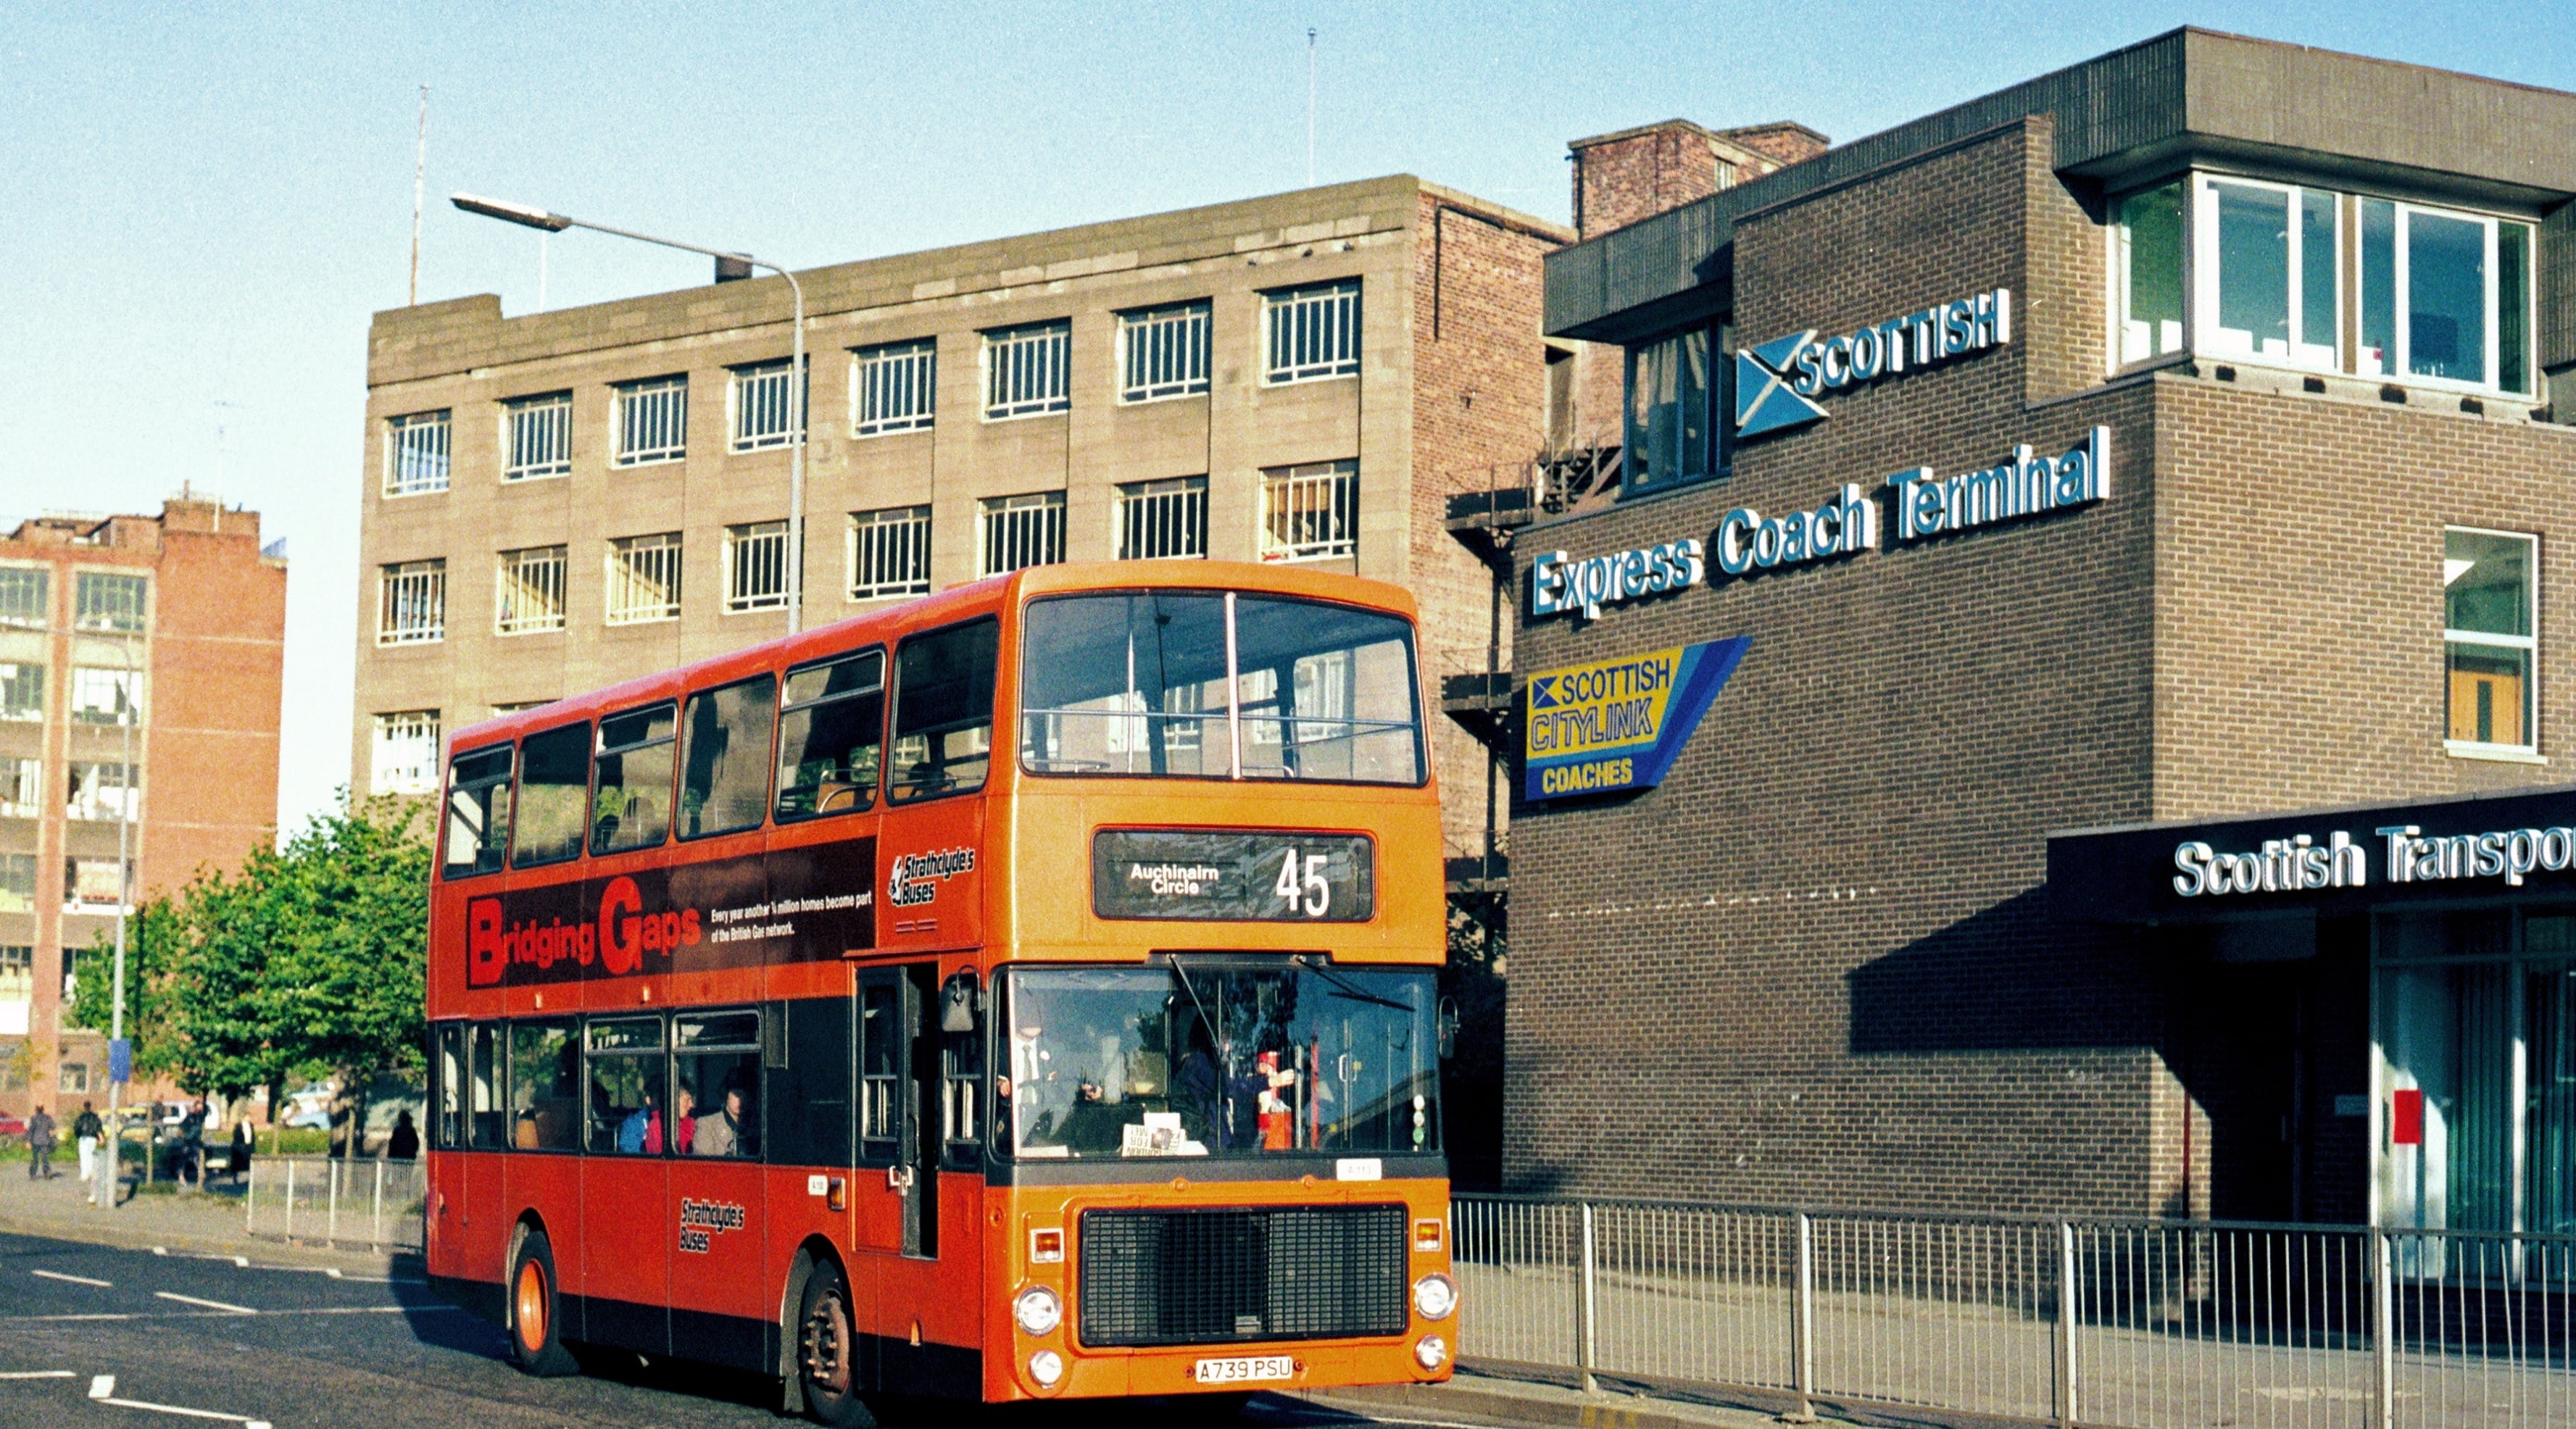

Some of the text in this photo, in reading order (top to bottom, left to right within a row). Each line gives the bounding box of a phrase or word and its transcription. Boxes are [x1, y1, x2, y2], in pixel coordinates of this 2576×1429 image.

[1794, 288, 2010, 395] SCOTTISH
[1532, 425, 2111, 620] Express Coach Terminal
[1561, 657, 1671, 705] SCOTTISH
[1531, 696, 1654, 751] CITYLINK
[1542, 757, 1633, 793] COACHES
[904, 846, 975, 881] Strathclyde's
[2173, 825, 2576, 897] Scottish Transpo
[902, 880, 936, 906] Buses
[1131, 849, 1329, 917] Auchinairn 45
[1151, 878, 1200, 894] Circle
[711, 909, 728, 924] Every
[729, 907, 744, 923] year
[744, 904, 770, 919] another
[778, 899, 799, 915] million
[801, 897, 824, 912] homes
[826, 892, 855, 909] become
[855, 890, 872, 909] part
[471, 875, 701, 984] Bridging Gaps
[711, 921, 794, 943] of the British Gas network.
[681, 1198, 744, 1233] Strathclyde's
[680, 1225, 709, 1252] Buses
[1200, 1359, 1290, 1379] A739 PSU
